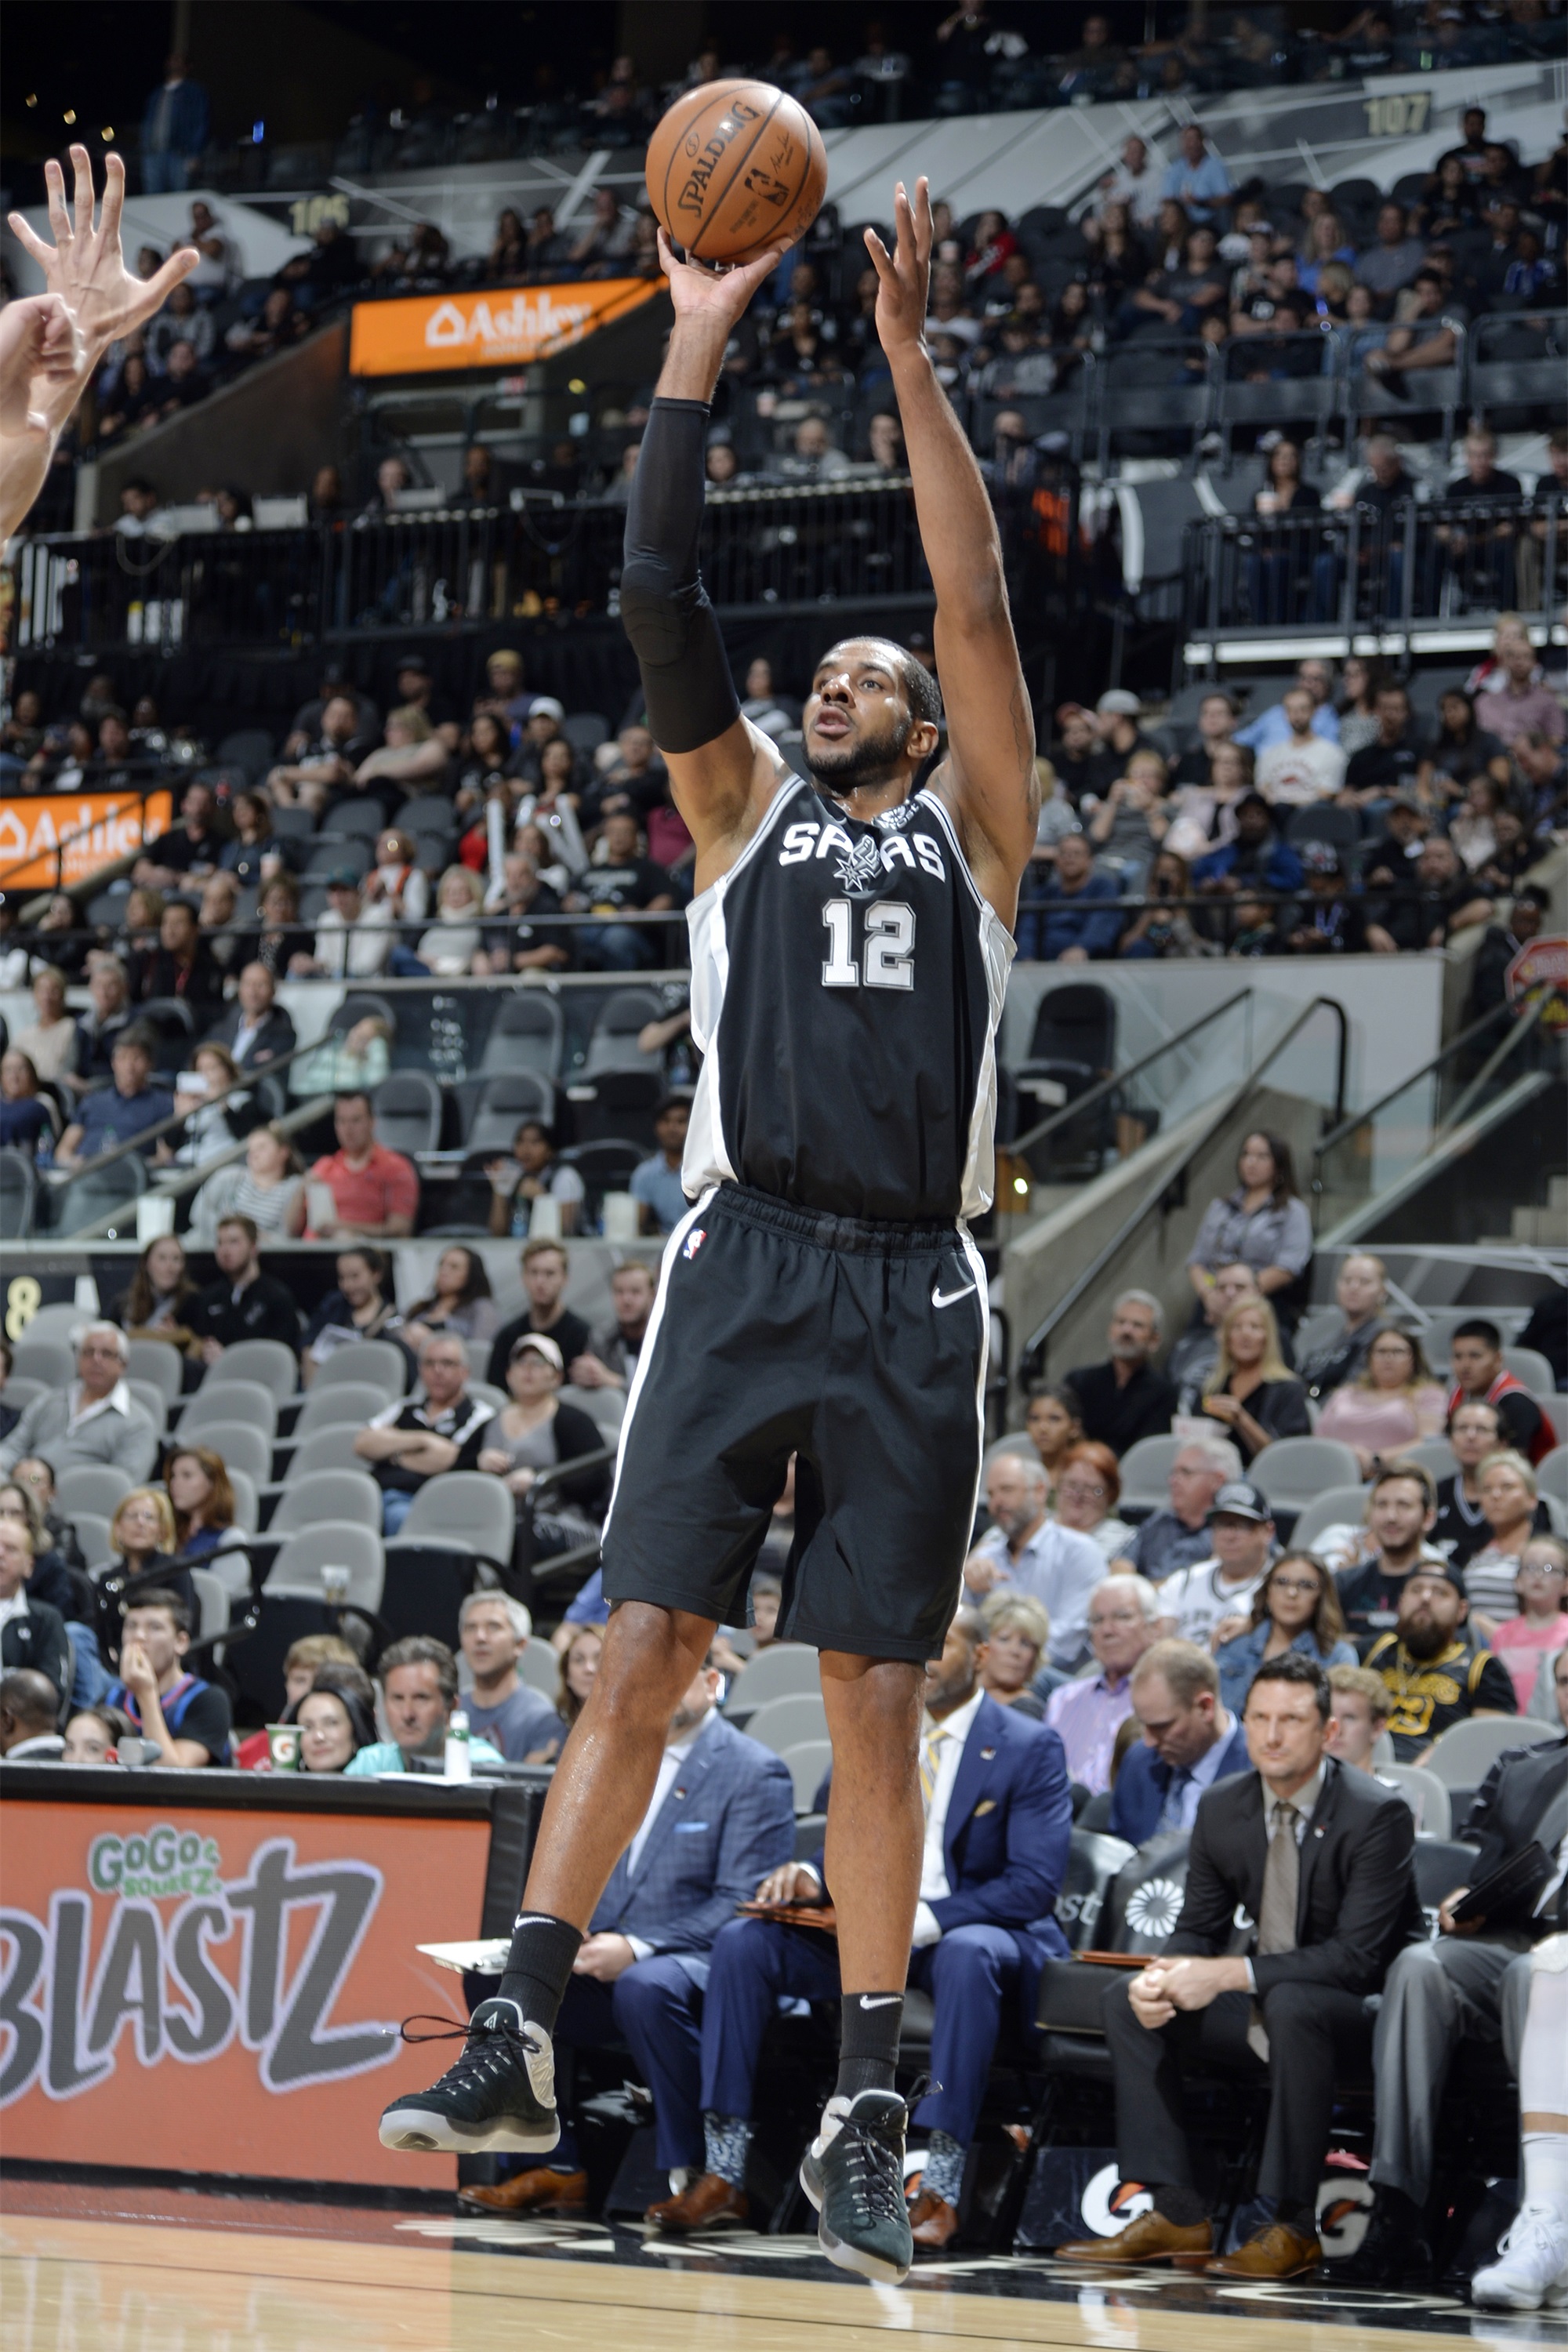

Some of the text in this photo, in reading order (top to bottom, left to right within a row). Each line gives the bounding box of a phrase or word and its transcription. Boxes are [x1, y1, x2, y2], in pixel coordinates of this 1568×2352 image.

[1363, 95, 1430, 135] 107
[677, 101, 760, 219] SPALDING
[822, 898, 916, 991] 12
[271, 1733, 297, 1762] G
[1081, 2161, 1155, 2238] G
